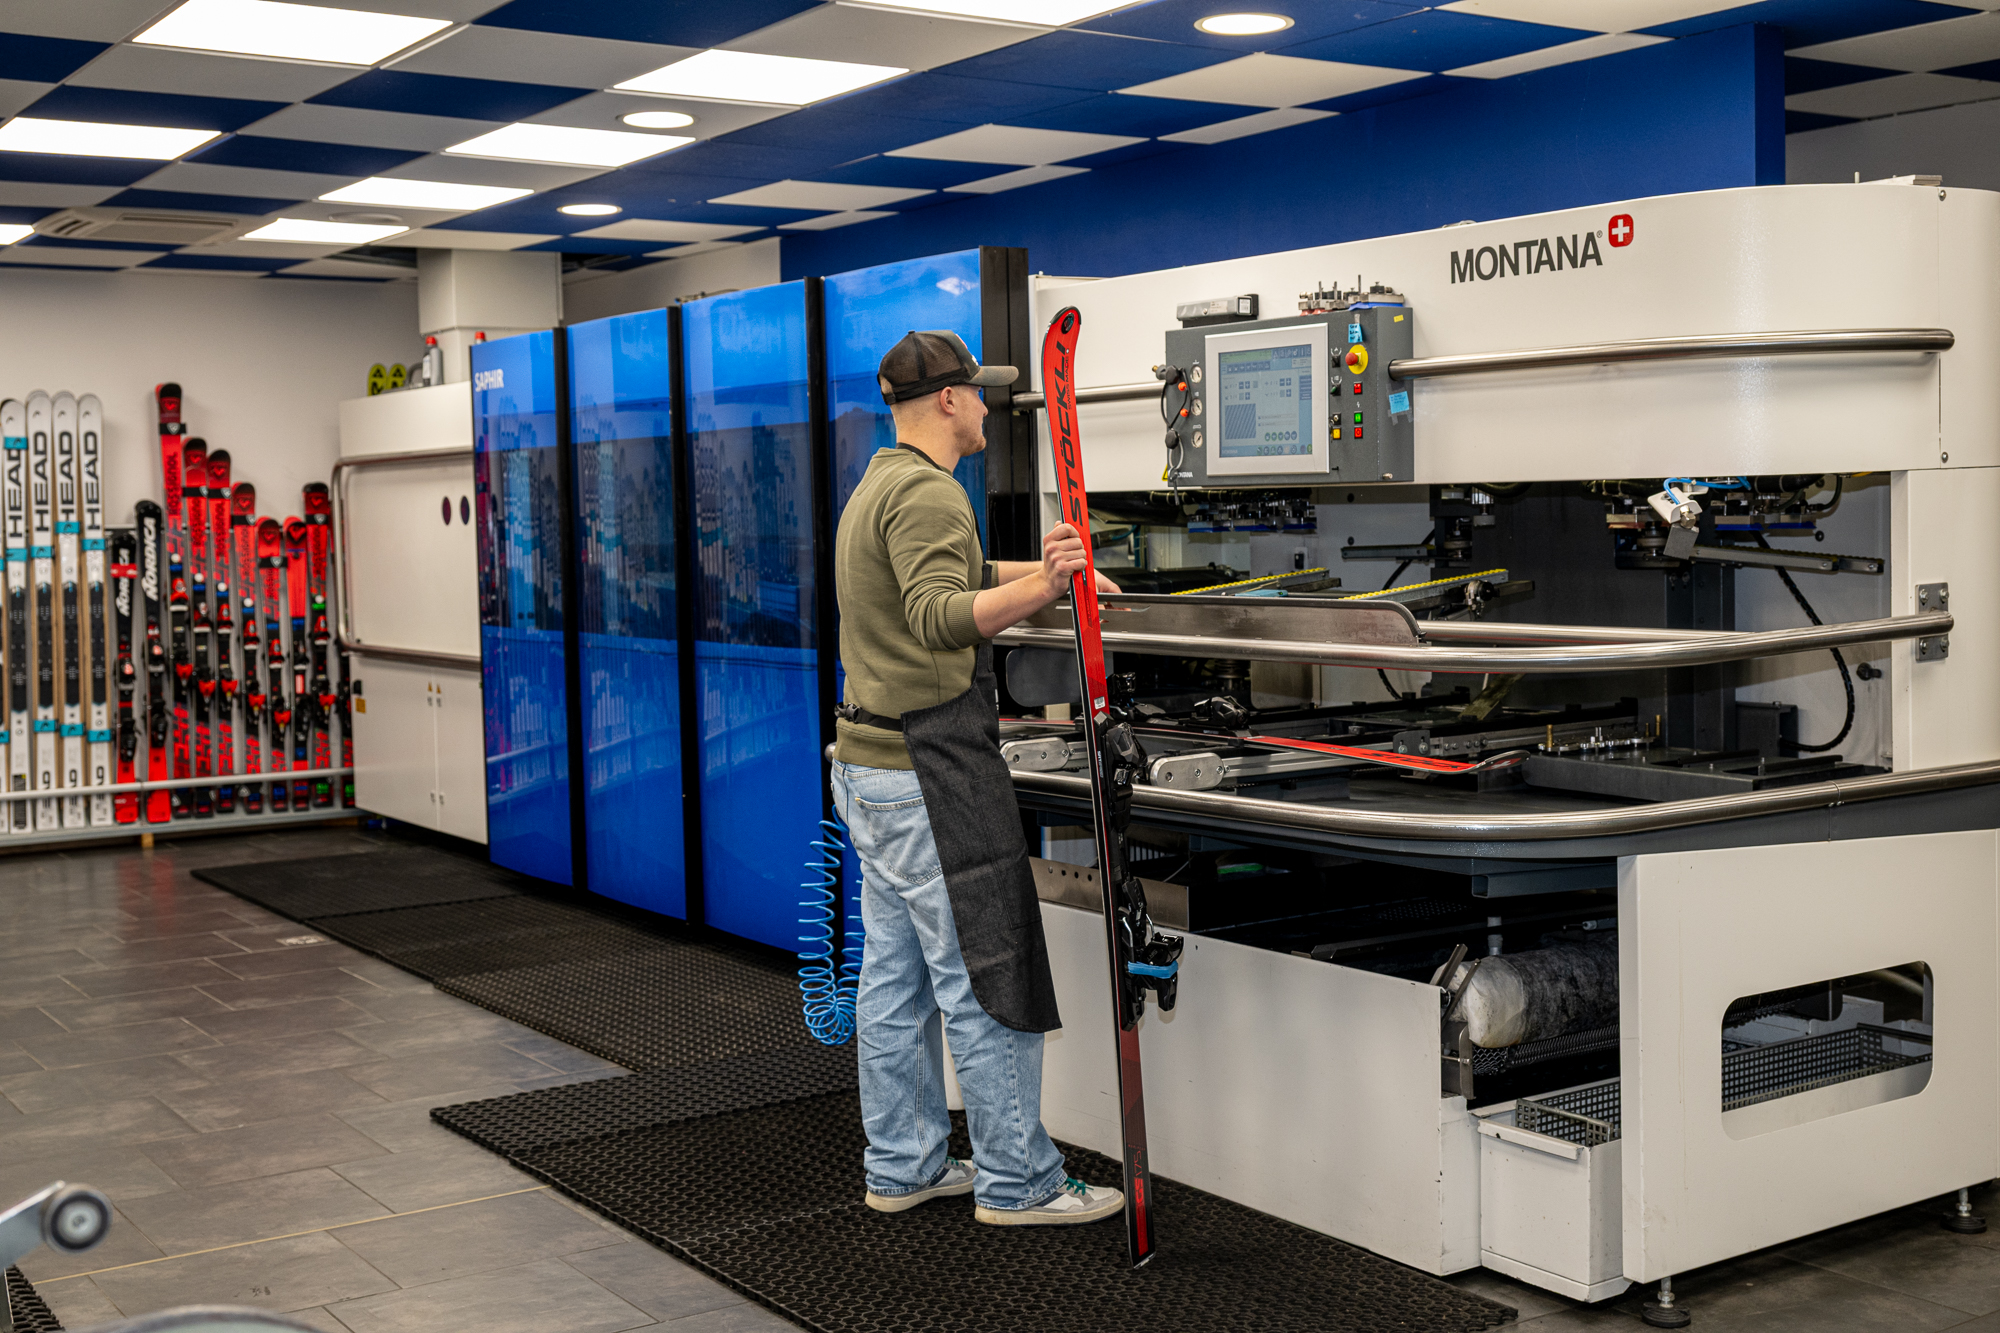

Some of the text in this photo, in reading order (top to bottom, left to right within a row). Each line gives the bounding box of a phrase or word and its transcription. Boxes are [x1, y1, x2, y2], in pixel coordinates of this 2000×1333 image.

[474, 368, 505, 392] SAPHIR
[33, 431, 49, 532] HEAD
[84, 431, 100, 530] HEAD
[116, 548, 130, 617] NORCA
[141, 516, 158, 601] NORDICA
